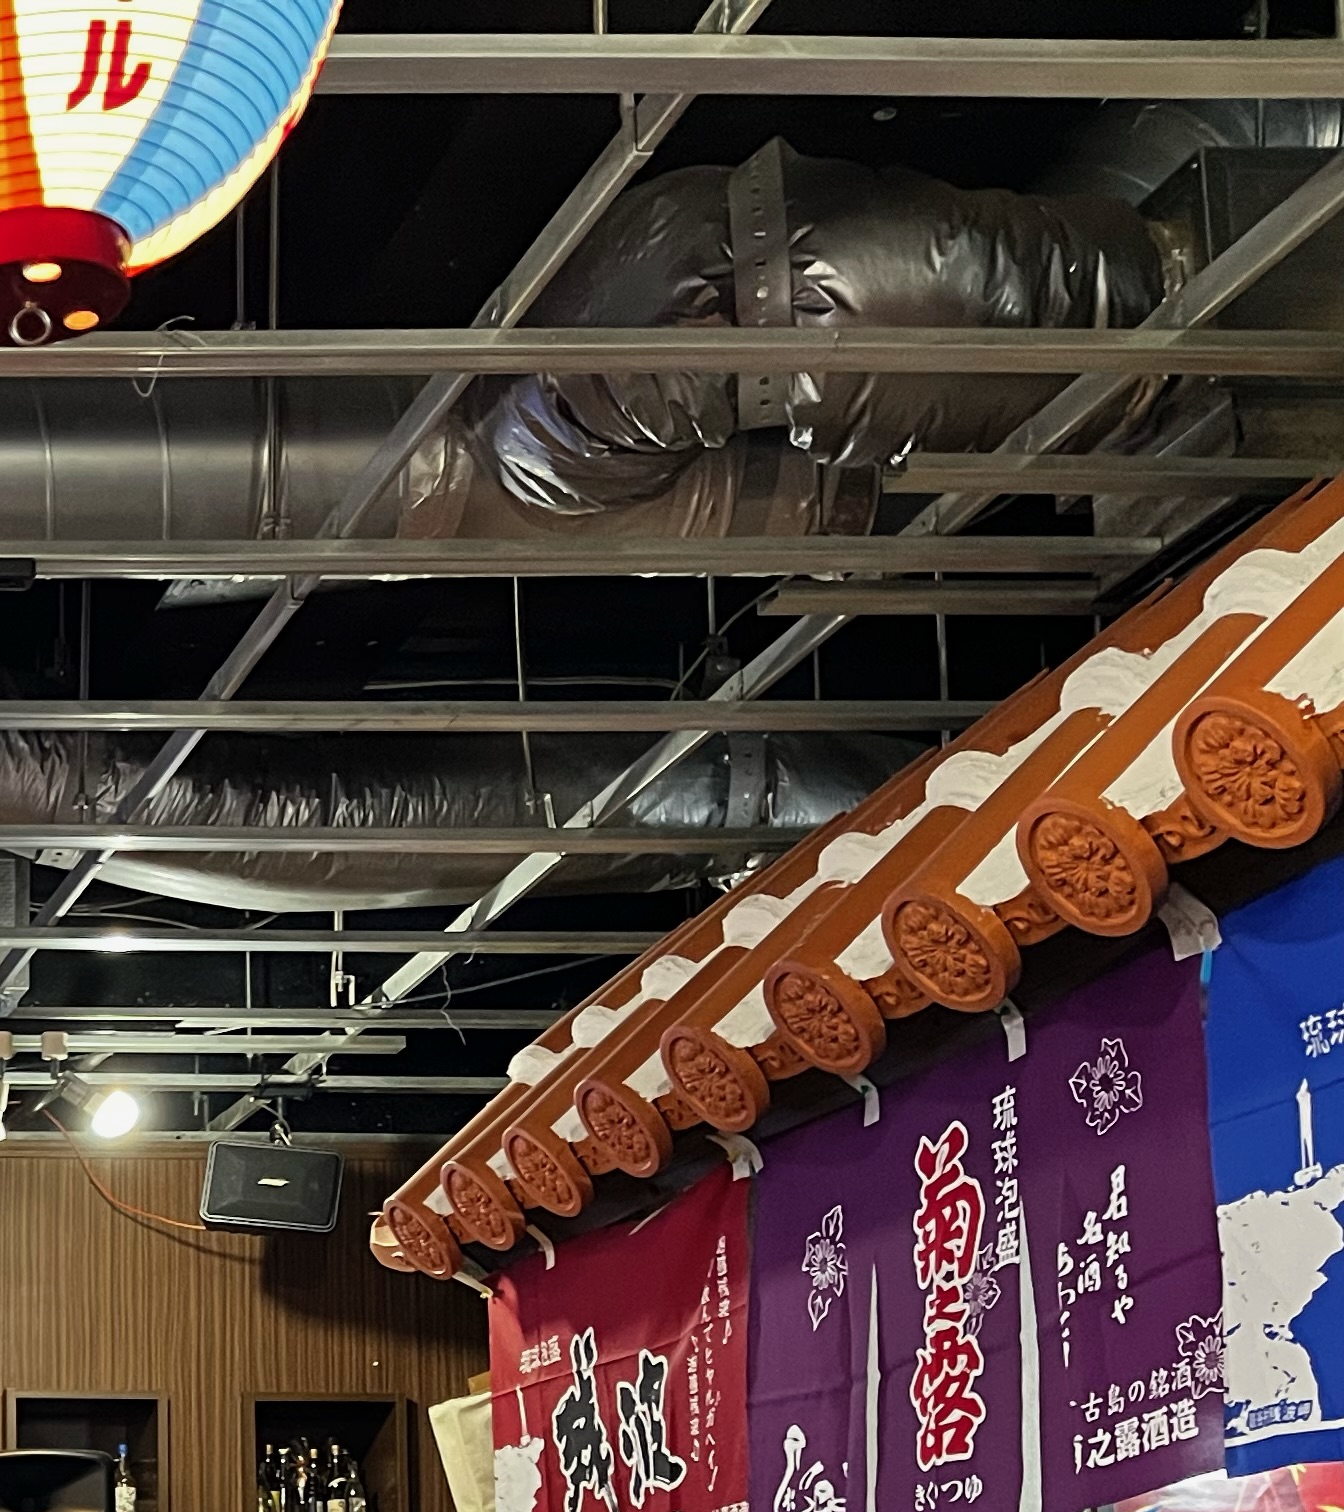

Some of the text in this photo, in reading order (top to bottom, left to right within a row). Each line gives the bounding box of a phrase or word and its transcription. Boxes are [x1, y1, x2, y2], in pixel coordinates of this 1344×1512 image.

[990, 1084, 1021, 1270] 琉球泡盛
[1077, 1210, 1104, 1295] 名酒
[911, 1120, 986, 1472] 菊之露
[1068, 1360, 1192, 1425] 古島の銘酒
[1073, 1397, 1201, 1475] 之露酒造
